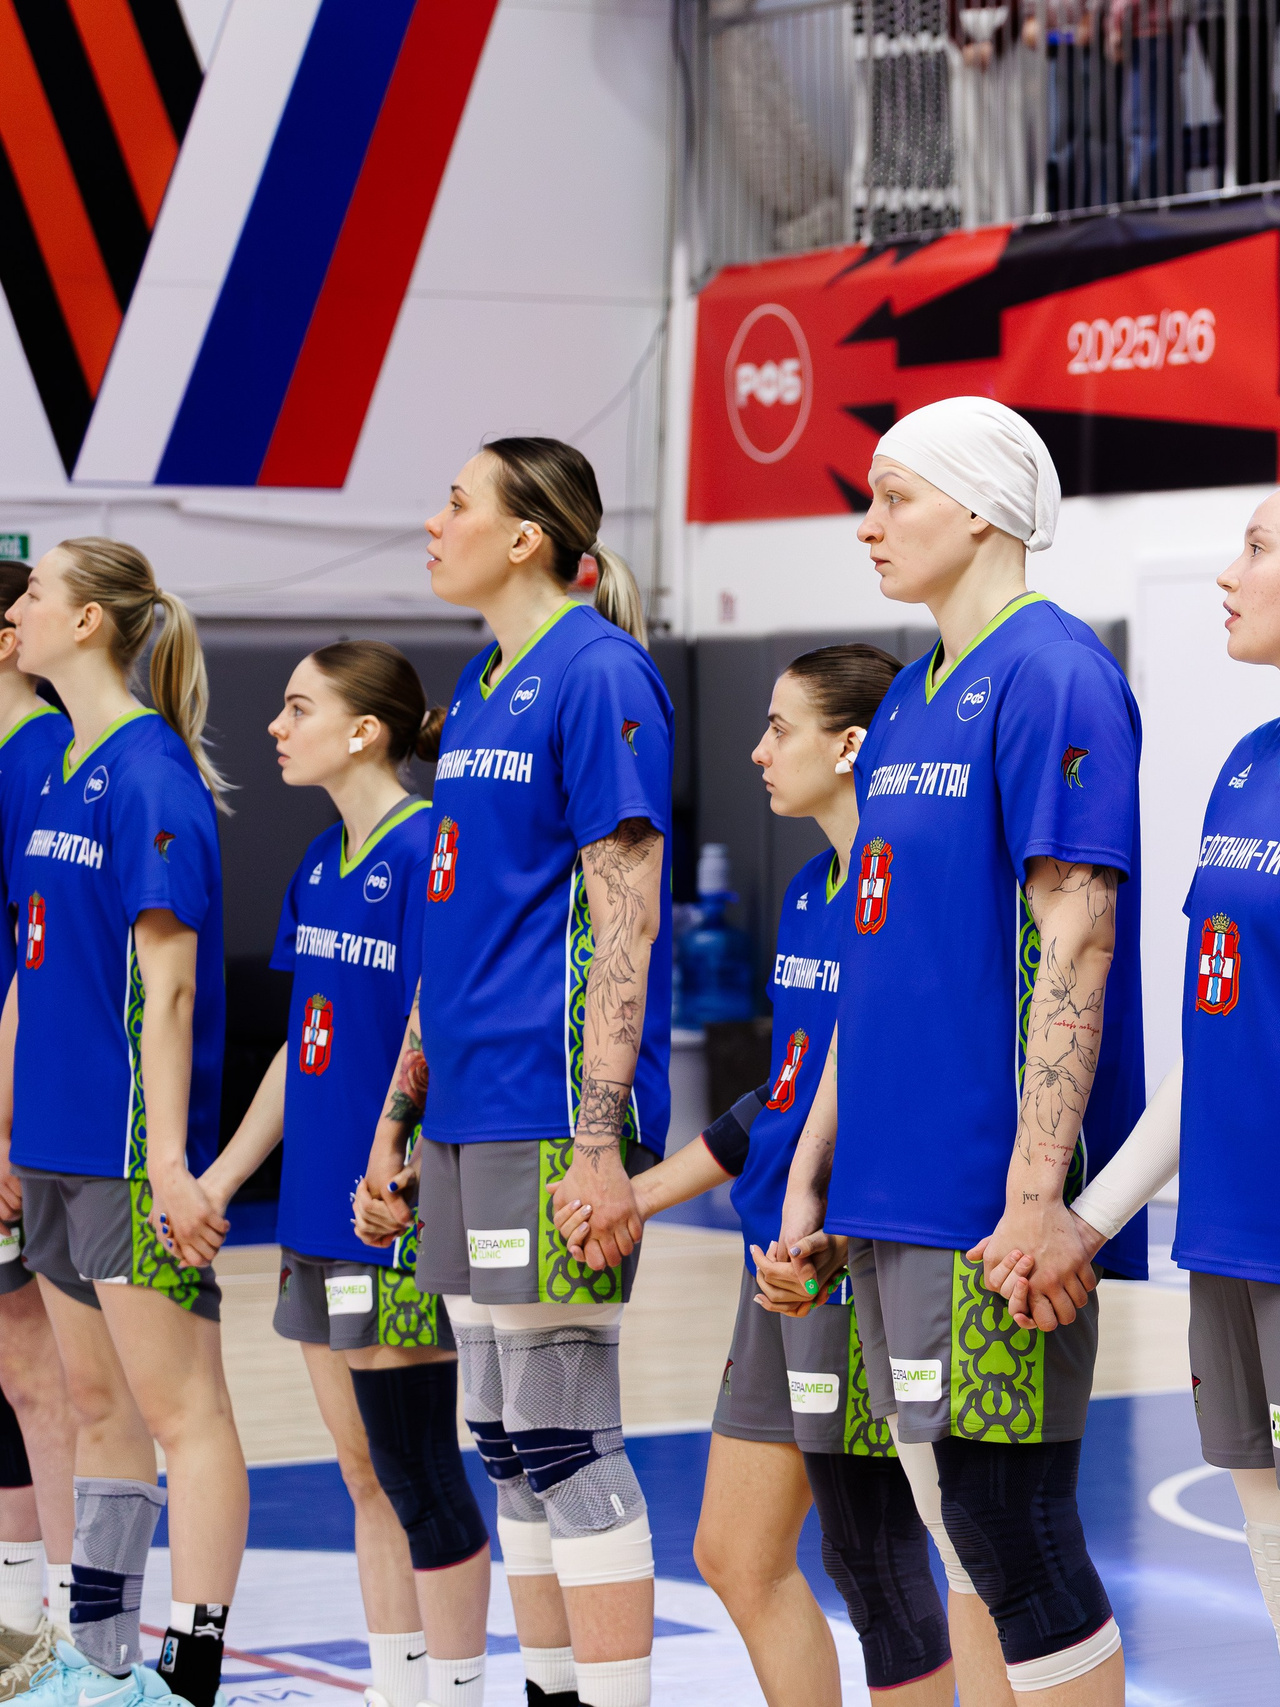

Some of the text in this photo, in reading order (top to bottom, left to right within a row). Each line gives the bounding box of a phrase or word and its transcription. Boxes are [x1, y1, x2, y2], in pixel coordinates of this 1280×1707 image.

[1066, 307, 1217, 375] 2025/26
[735, 359, 803, 408] РФБ
[514, 688, 535, 702] РФБ
[962, 690, 985, 705] РФБ
[477, 1238, 526, 1250] EZRAMED
[893, 1368, 937, 1381] EZRAMED
[791, 1380, 834, 1394] EZRAMED
